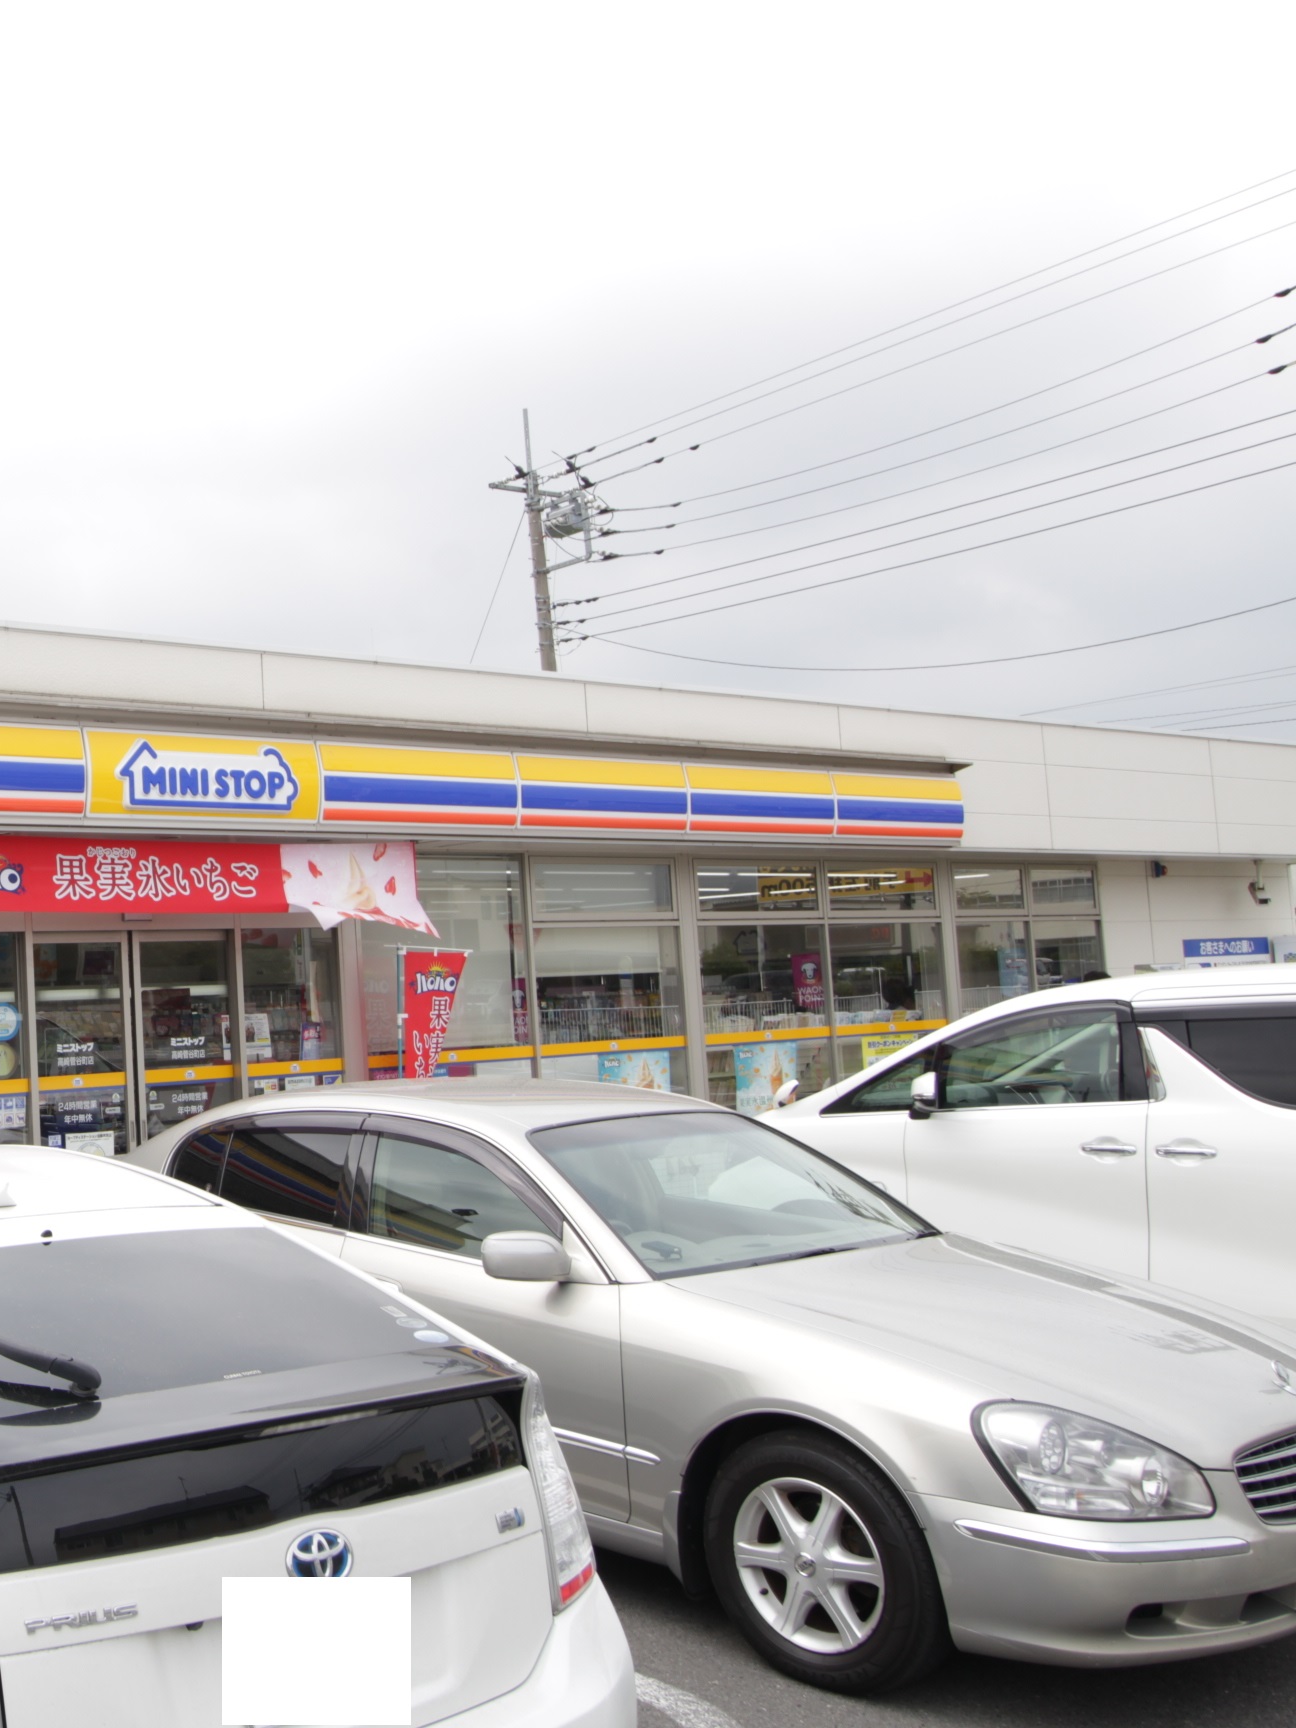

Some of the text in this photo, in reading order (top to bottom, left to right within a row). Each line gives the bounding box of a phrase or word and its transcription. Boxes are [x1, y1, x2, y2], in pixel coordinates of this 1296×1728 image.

[141, 765, 285, 799] MINI STOP
[53, 854, 259, 901] 果実氷いちご
[56, 1042, 95, 1053] ミニストップ
[170, 1036, 206, 1047] ミニストップ
[171, 1091, 209, 1103] 24時間営業
[58, 1100, 98, 1112] 24時間営業
[177, 1104, 205, 1115] 年中無休
[63, 1113, 94, 1125] 年中無休
[24, 1602, 139, 1636] PRIUS
